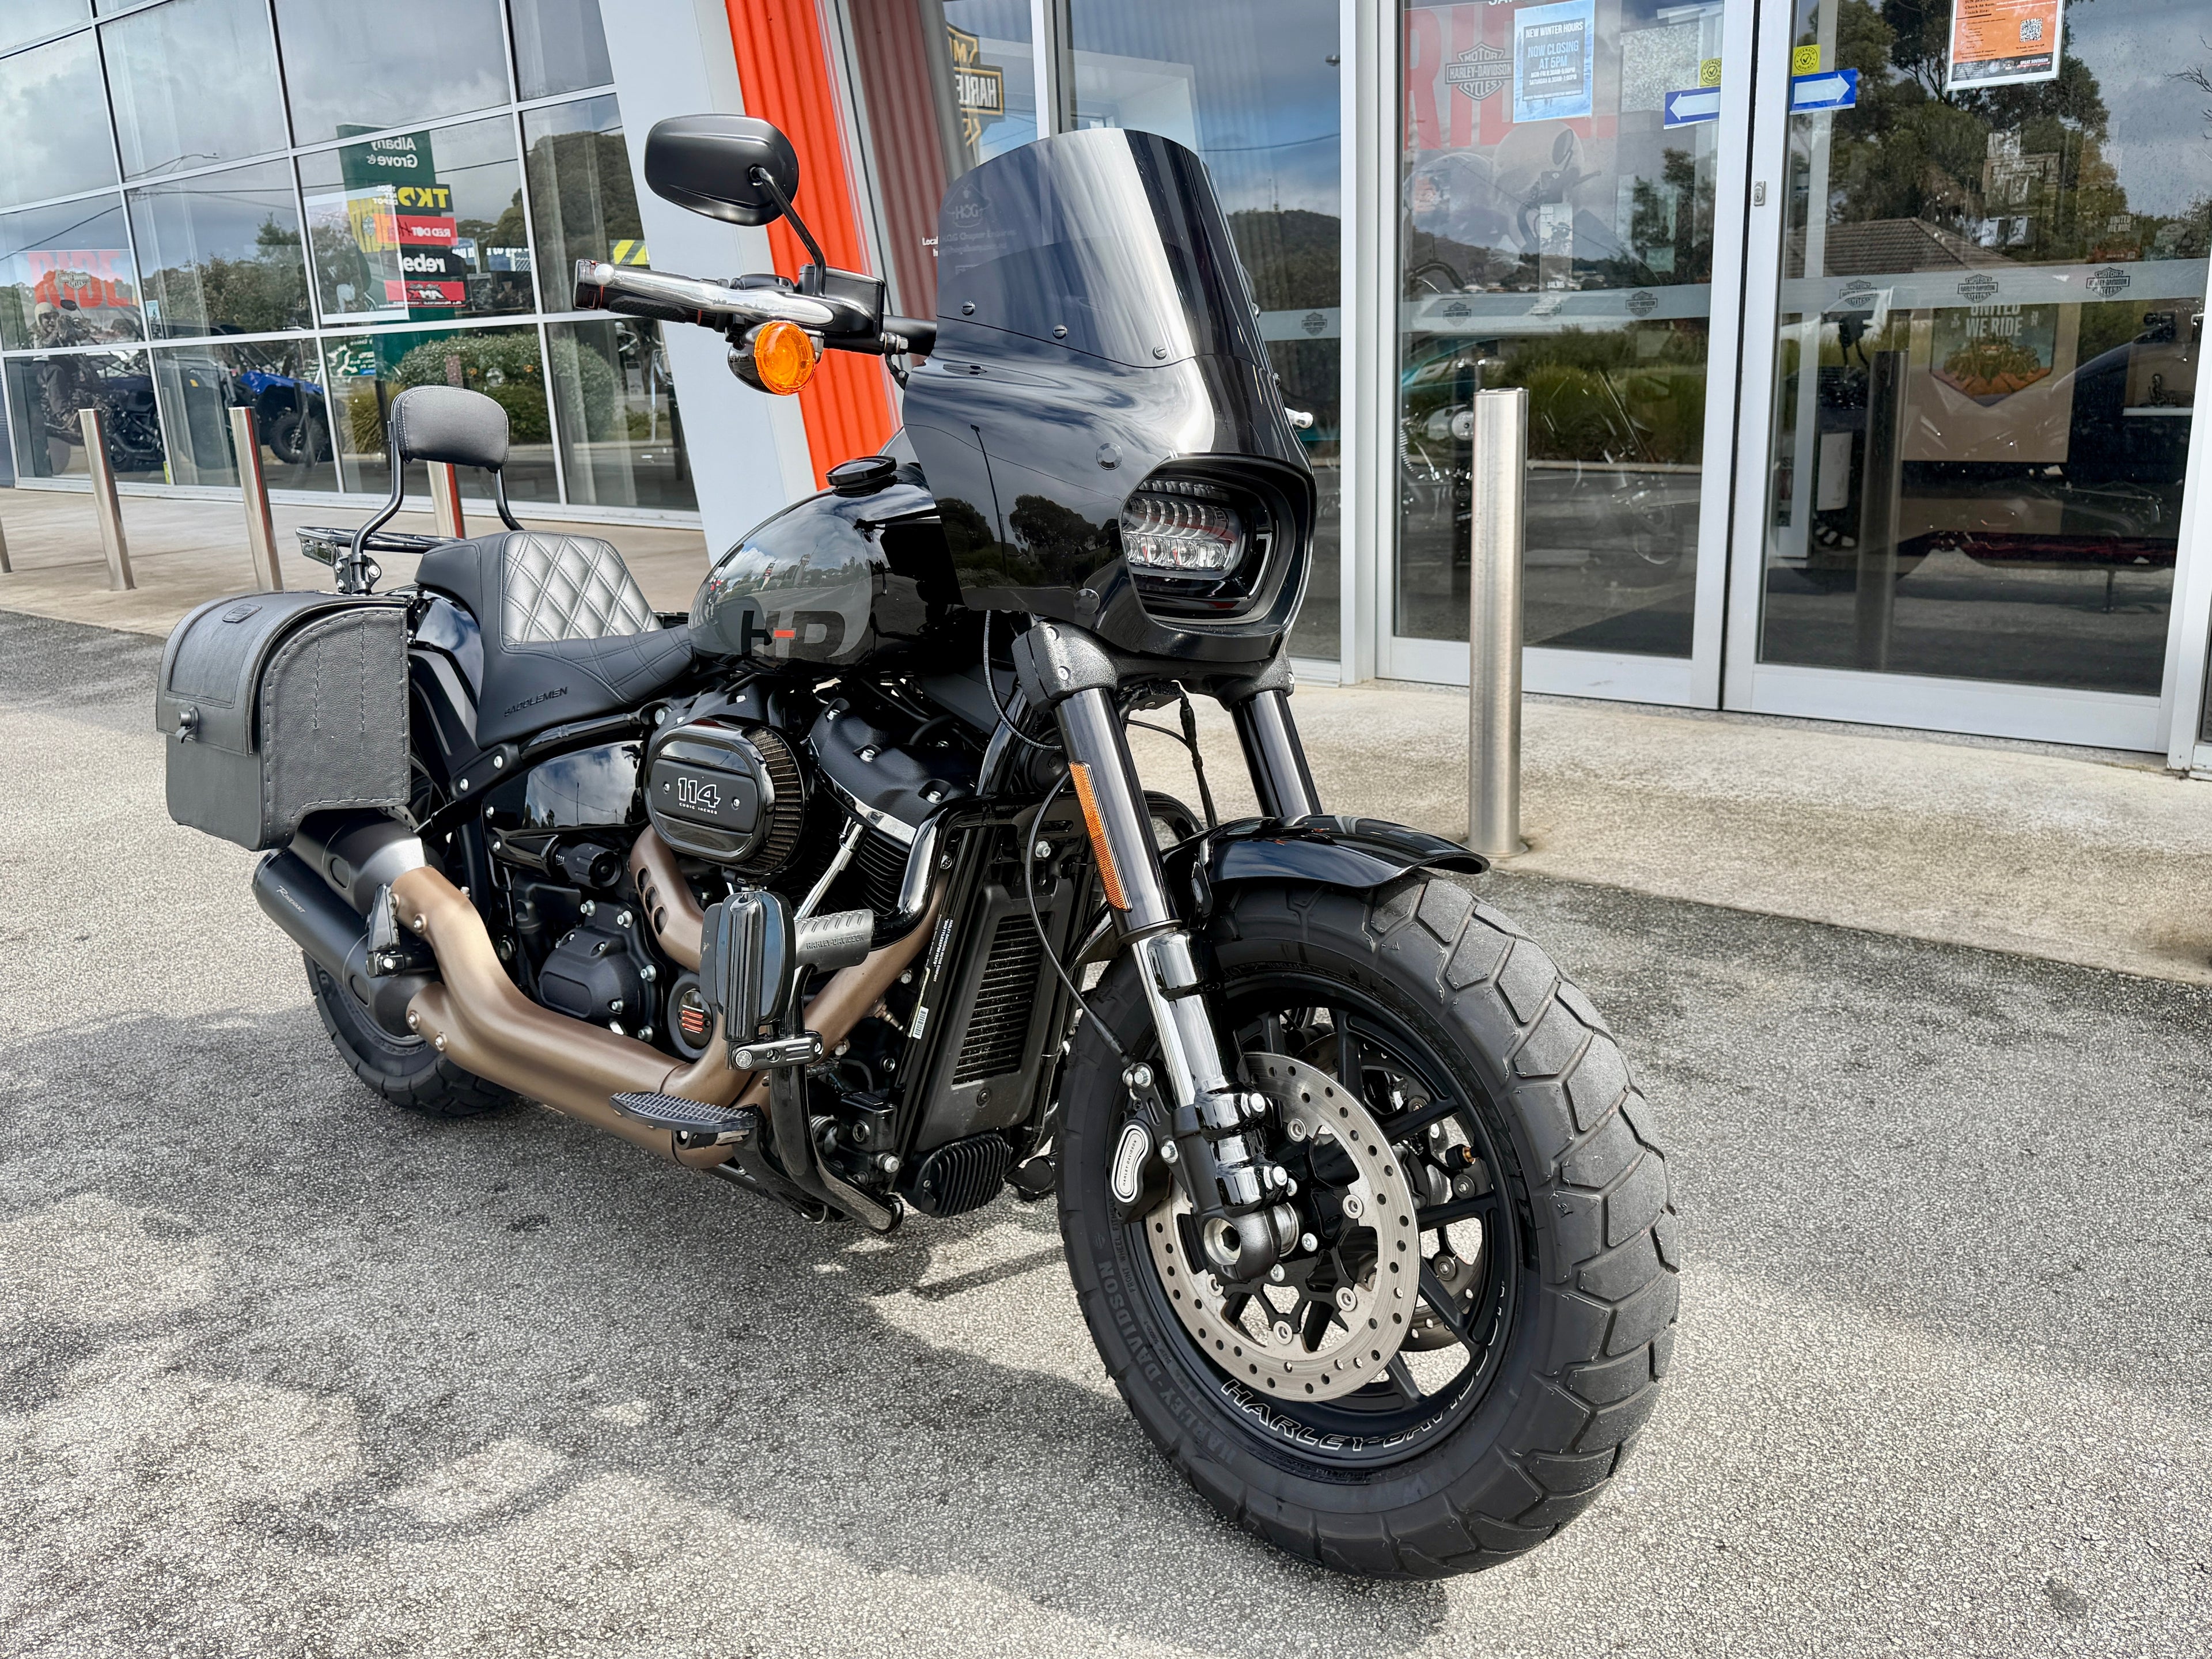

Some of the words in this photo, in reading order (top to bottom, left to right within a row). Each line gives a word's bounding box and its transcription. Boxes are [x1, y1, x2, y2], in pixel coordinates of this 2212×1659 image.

[1526, 29, 1539, 38] NEW
[1540, 25, 1563, 36] WINTER
[1563, 22, 1584, 33] HOURS
[1464, 47, 1498, 62] MOTOR
[1528, 46, 1545, 58] NOW
[1547, 40, 1579, 55] CLOSING
[1449, 63, 1512, 79] HARLEY-DAVIDSON
[1539, 58, 1550, 70] AT
[1464, 80, 1498, 97] CYCLES
[1966, 318, 1987, 338] WE
[1991, 317, 2023, 337] RIDE
[504, 687, 569, 717] SADDLEMEN
[677, 777, 721, 809] 114
[698, 807, 718, 815] INCHES
